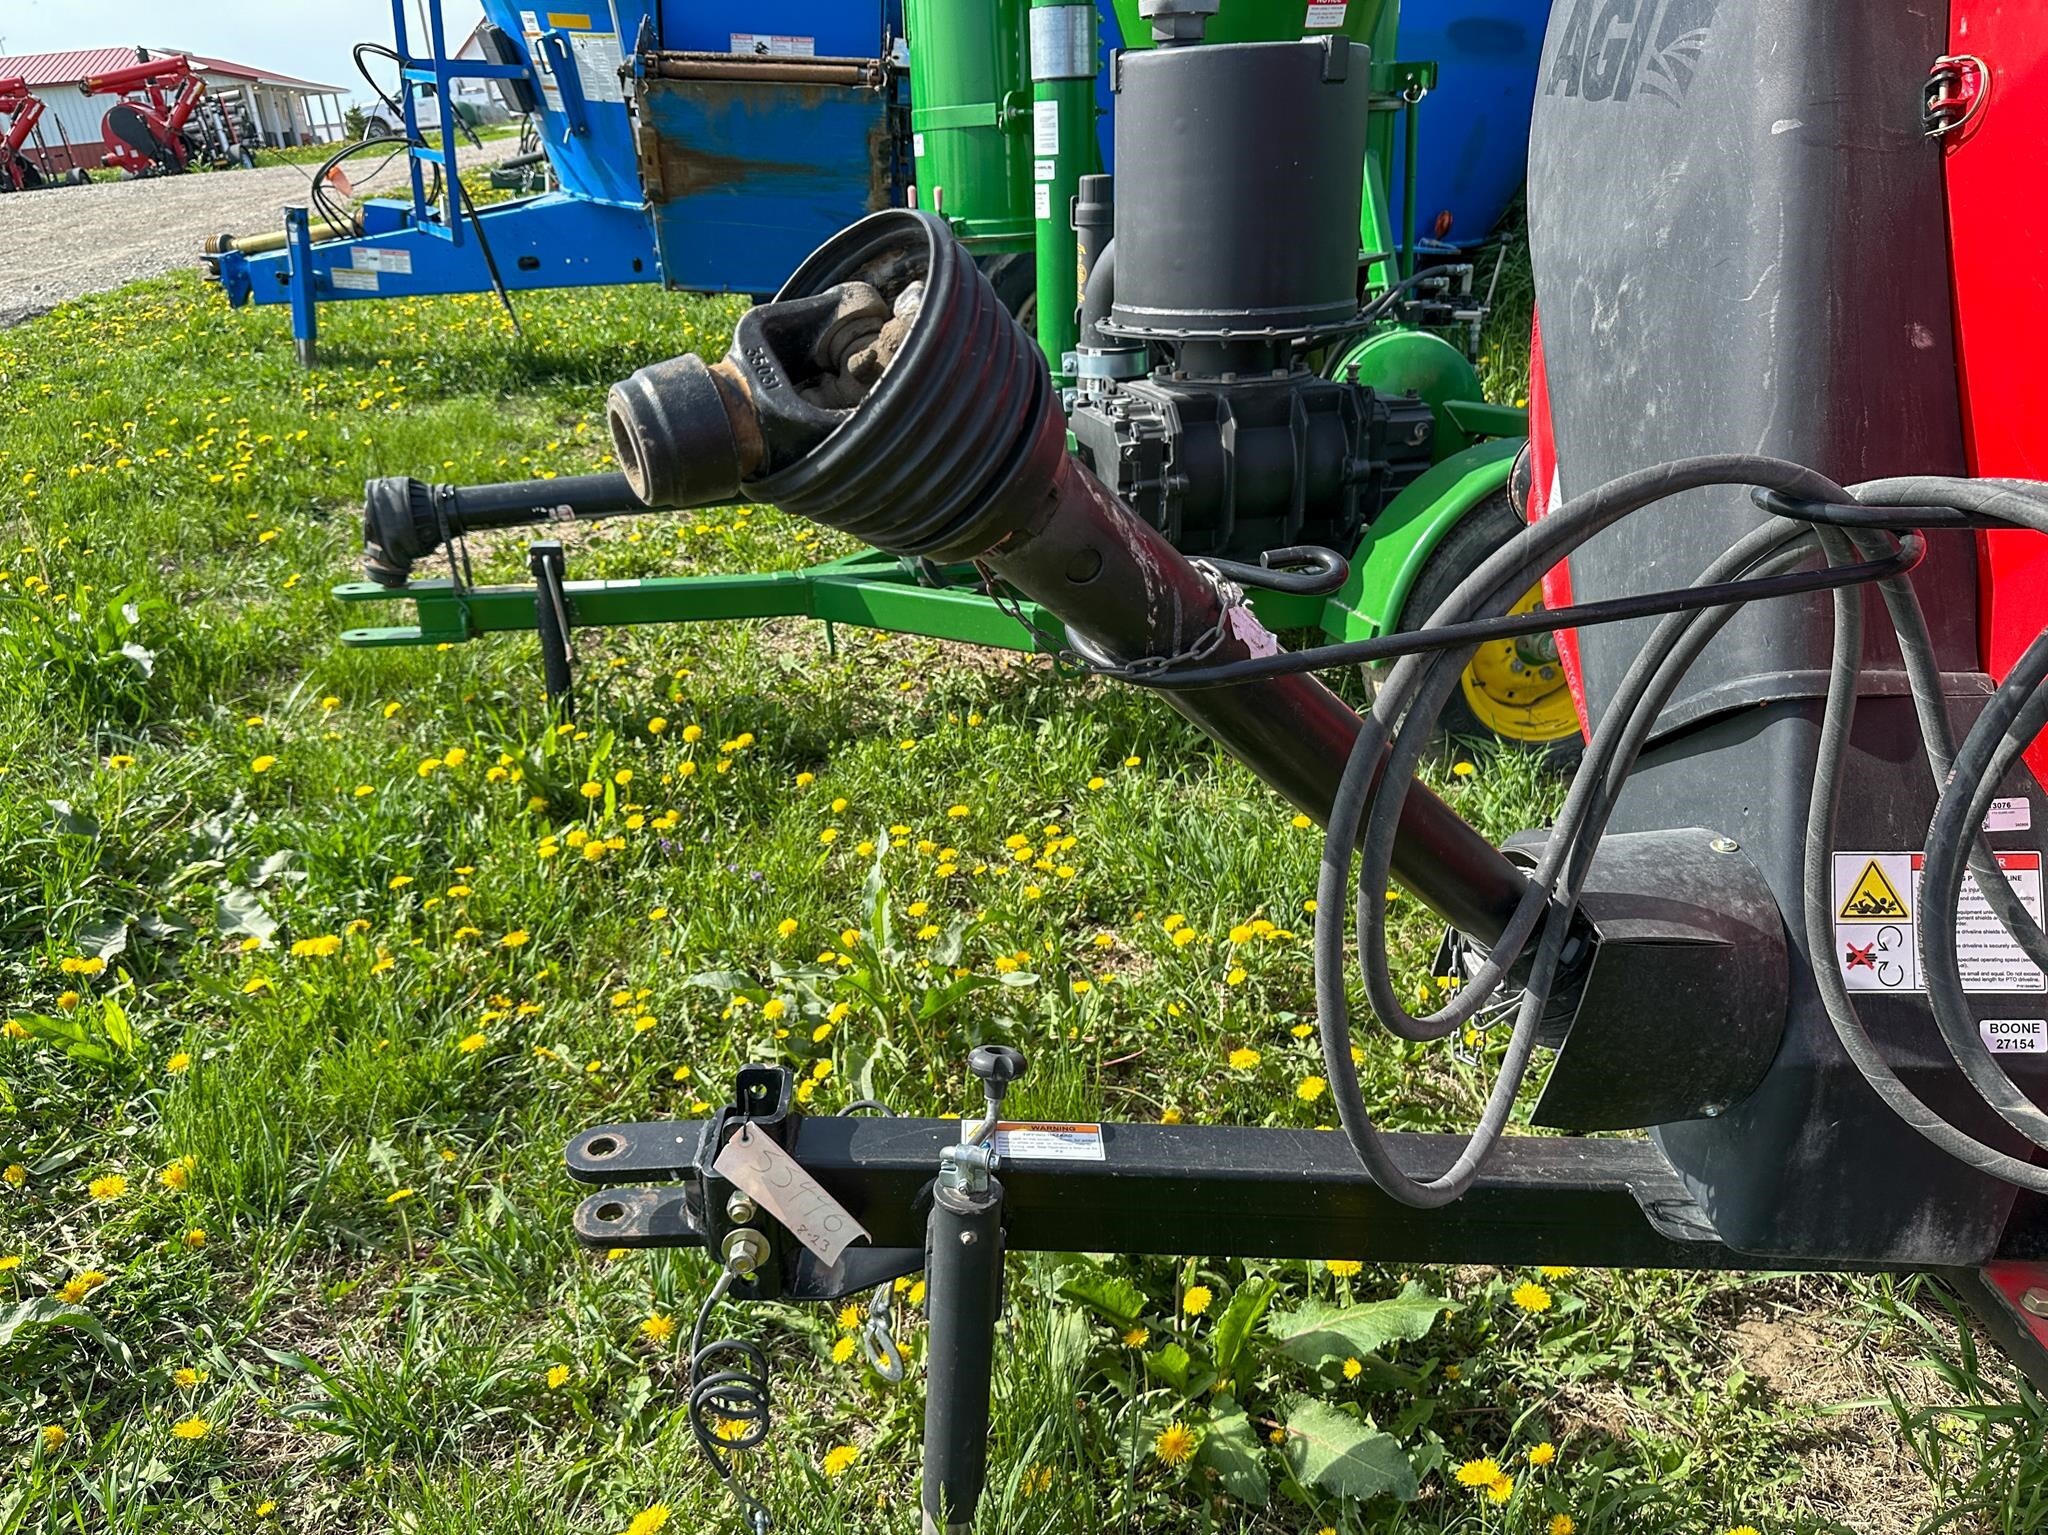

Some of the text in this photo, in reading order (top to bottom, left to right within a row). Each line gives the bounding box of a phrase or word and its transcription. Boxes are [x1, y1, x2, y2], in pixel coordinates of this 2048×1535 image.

[1545, 0, 1659, 102] AGI
[1990, 1023, 2040, 1034] BOONE
[1996, 1039, 2035, 1049] 27154
[1031, 1124, 1076, 1132] WARNING
